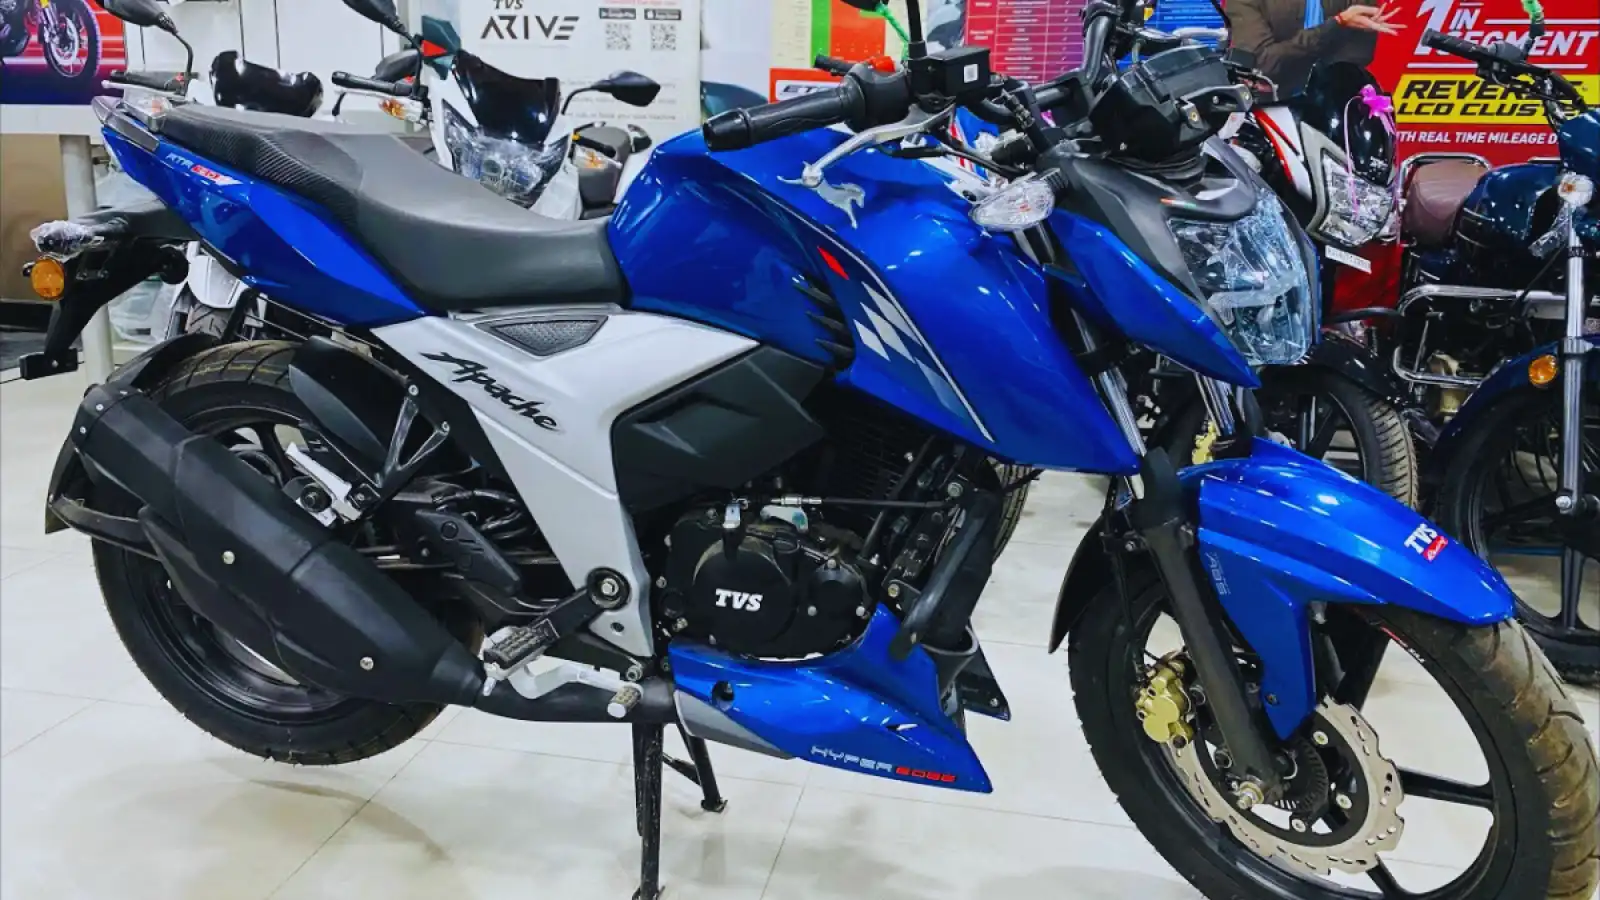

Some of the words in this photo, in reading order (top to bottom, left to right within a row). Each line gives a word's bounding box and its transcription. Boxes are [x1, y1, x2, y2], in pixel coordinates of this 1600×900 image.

[480, 15, 580, 40] ARIVE
[1449, 8, 1481, 30] IN
[1437, 31, 1599, 56] EGMENT
[1397, 103, 1454, 116] LCD
[1418, 131, 1451, 143] REAL
[1455, 131, 1485, 143] TIME
[1487, 132, 1547, 144] MILEAGE
[420, 352, 563, 432] Apache
[1404, 523, 1438, 554] TVS
[715, 588, 763, 612] TVS
[811, 745, 893, 773] HYPER
